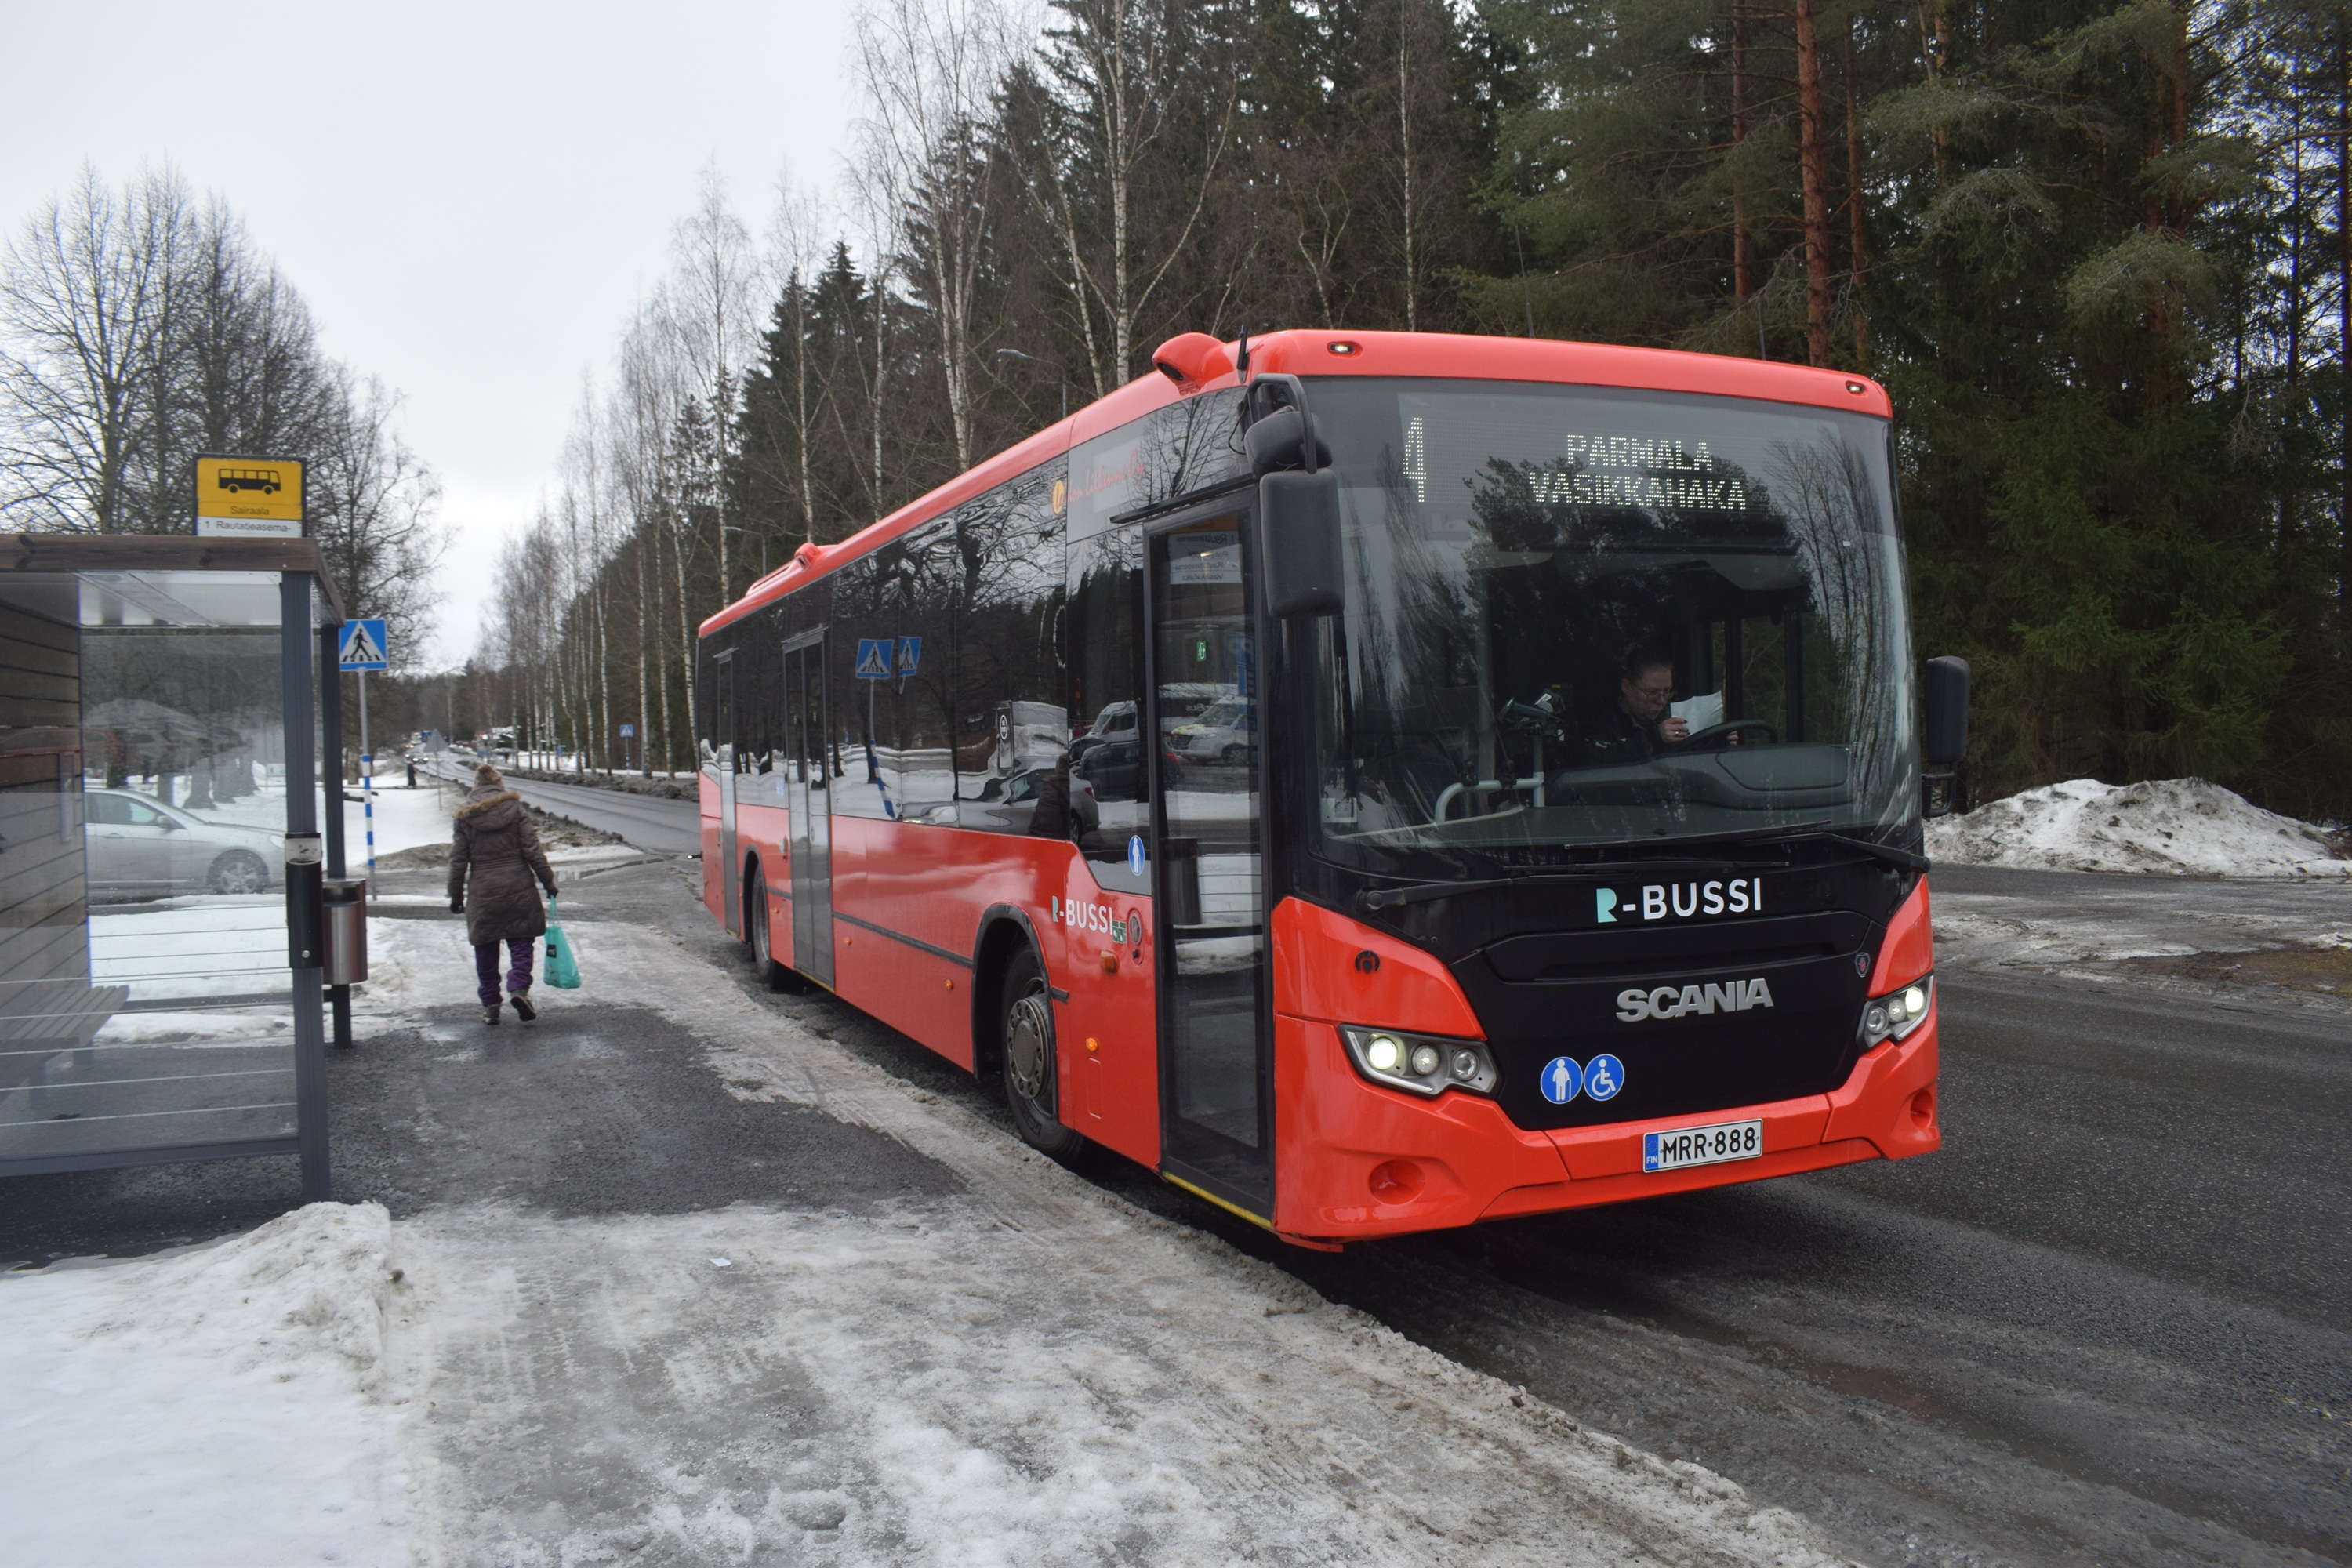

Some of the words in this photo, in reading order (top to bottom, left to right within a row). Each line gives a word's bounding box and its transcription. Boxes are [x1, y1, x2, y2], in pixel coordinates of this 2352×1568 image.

[1402, 417, 1427, 503] 4
[1567, 434, 1712, 471] PARMALA
[1529, 471, 1746, 510] VASIKKAHAKA
[216, 521, 291, 532] Rautatieasema-
[230, 506, 270, 516] Sairaala
[1052, 895, 1113, 935] R-BUSSI
[1595, 877, 1762, 924] R-BUSSI
[1616, 978, 1774, 1022] SCANIA
[1646, 1155, 1658, 1165] FIN
[1662, 1127, 1756, 1163] MRR-888
